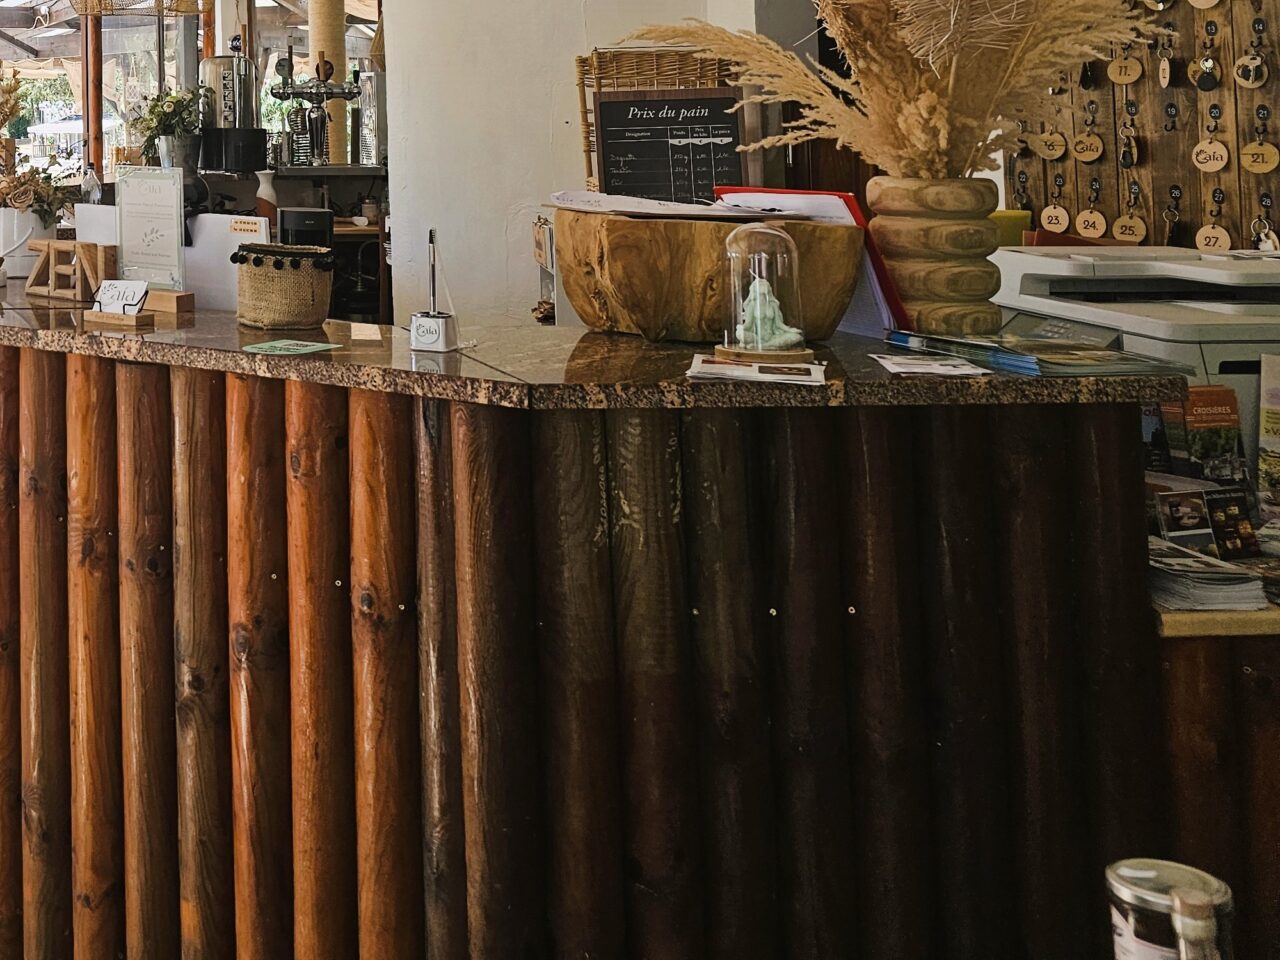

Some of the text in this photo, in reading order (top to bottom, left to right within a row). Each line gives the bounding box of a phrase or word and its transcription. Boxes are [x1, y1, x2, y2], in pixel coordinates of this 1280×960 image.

[1207, 25, 1216, 33] 13
[1255, 23, 1263, 31] 14
[628, 105, 709, 121] Prix du pain
[1167, 107, 1176, 115] 19
[1211, 109, 1220, 117] 20
[1258, 110, 1268, 118] 21
[1056, 177, 1063, 185] 23
[1092, 181, 1100, 189] 24
[1172, 190, 1180, 198] 26
[1214, 193, 1222, 201] 27
[1262, 197, 1271, 206] 28
[24, 239, 118, 303] ZEN
